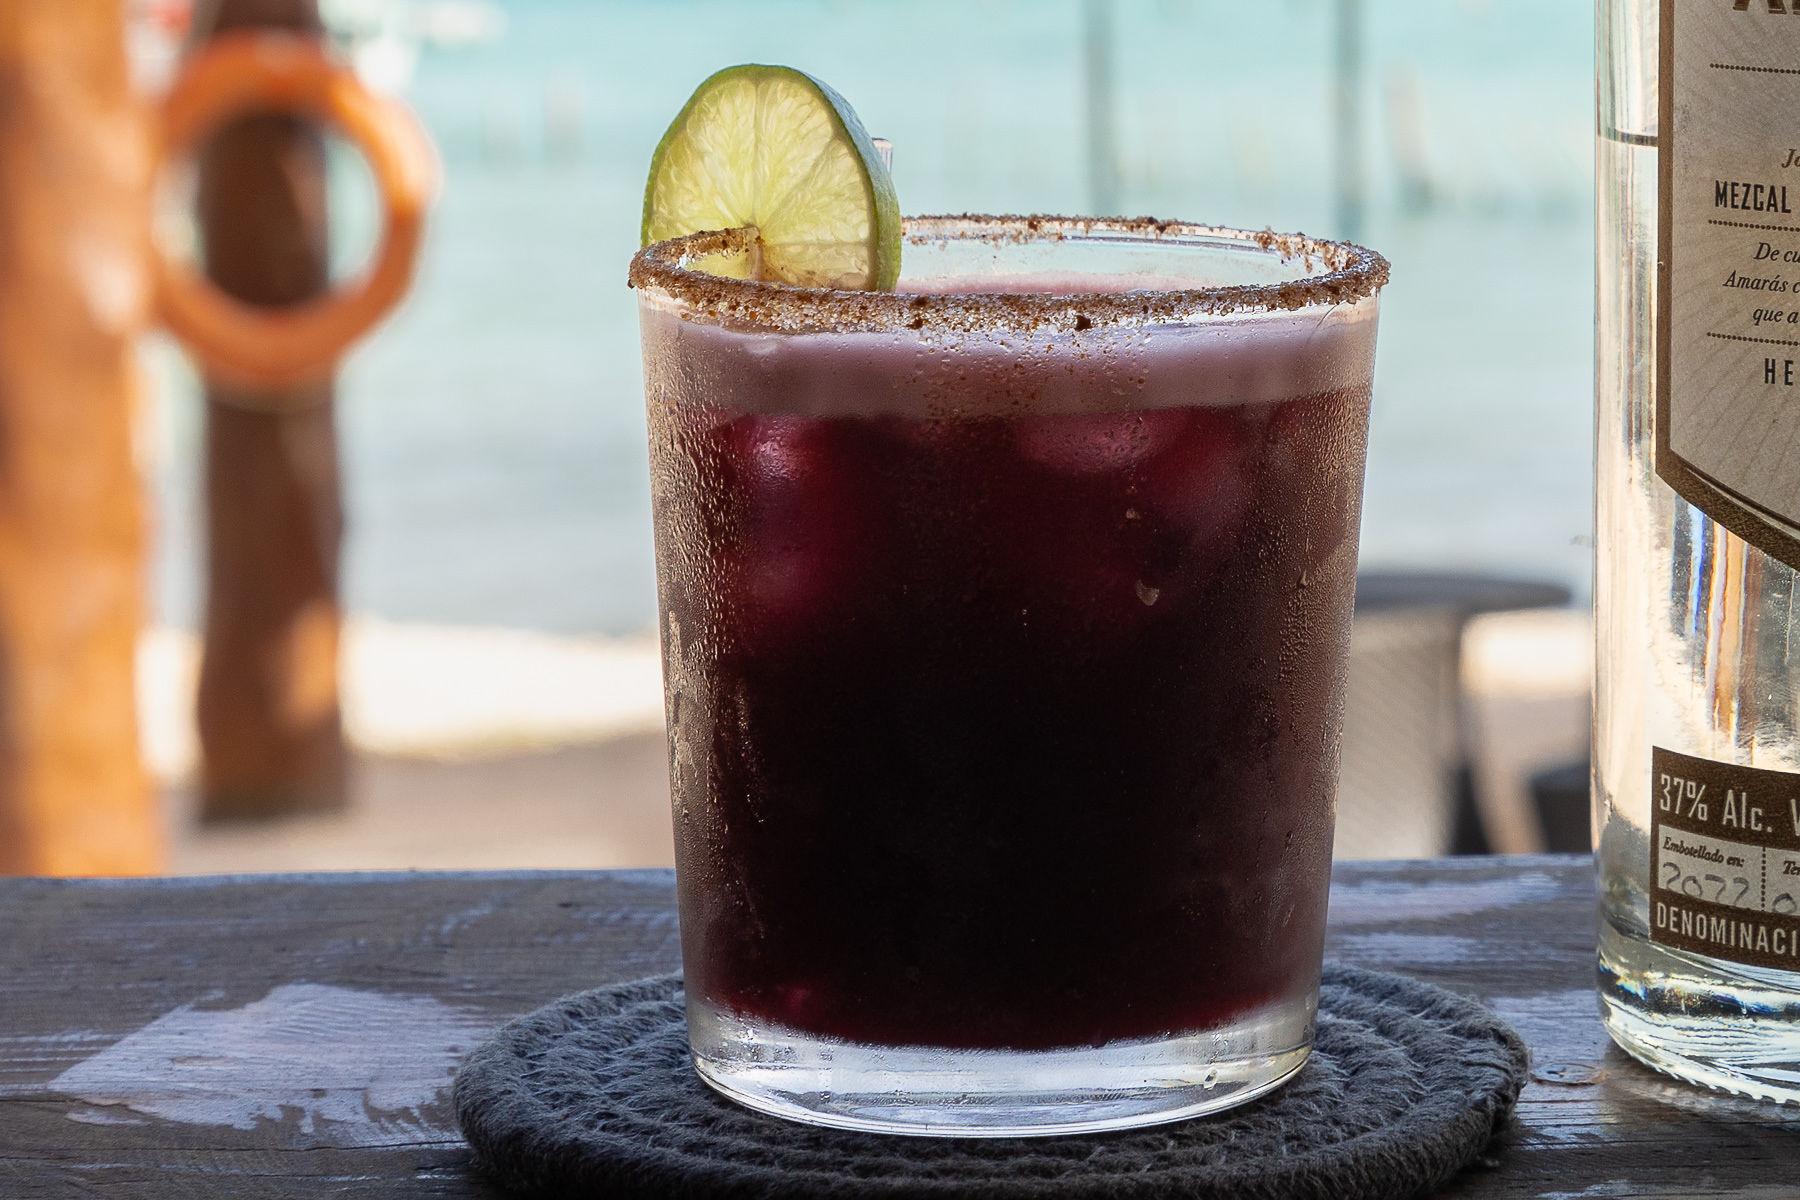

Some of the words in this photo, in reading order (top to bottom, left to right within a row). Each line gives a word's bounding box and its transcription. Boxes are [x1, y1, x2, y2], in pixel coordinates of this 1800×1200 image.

[1714, 180, 1792, 214] MEZCAL
[1754, 242, 1779, 261] De
[1722, 270, 1788, 293] Amarás
[1753, 308, 1784, 326] que
[1787, 311, 1799, 323] a
[1660, 773, 1708, 821] 37%
[1723, 789, 1773, 833] Alc.
[1663, 837, 1724, 864] Embotellado
